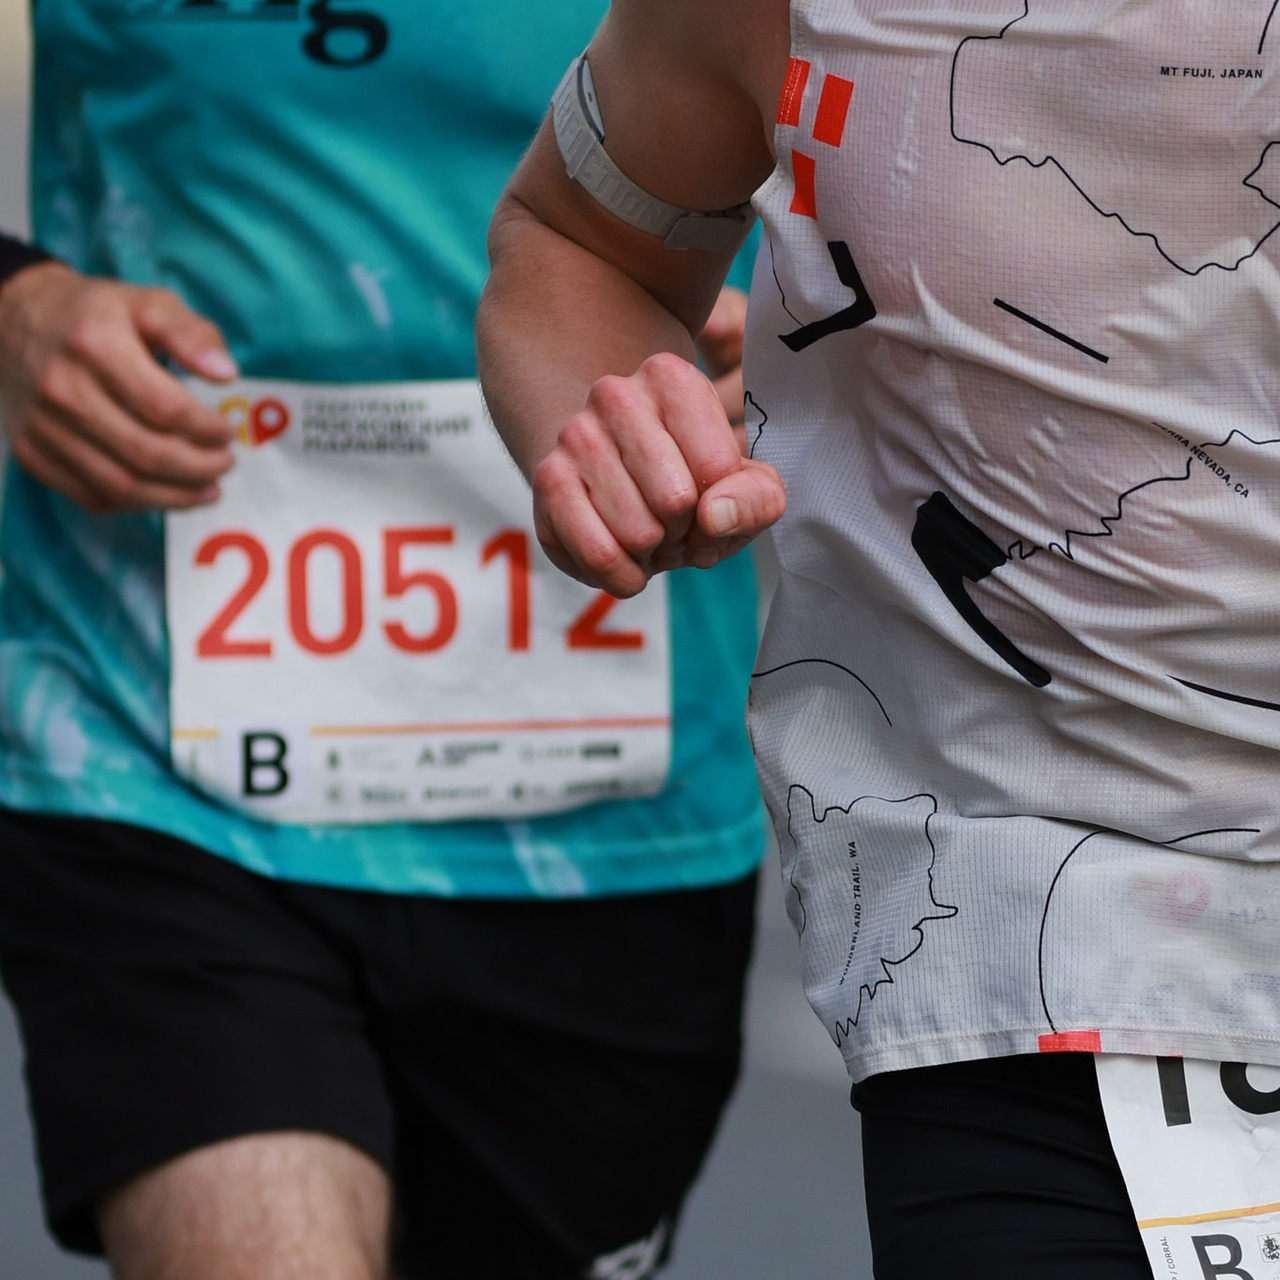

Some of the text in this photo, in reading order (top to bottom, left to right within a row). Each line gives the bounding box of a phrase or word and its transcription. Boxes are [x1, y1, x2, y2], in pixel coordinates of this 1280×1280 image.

[1160, 66, 1263, 79] MT FUJI, JAPAN
[1190, 445, 1231, 486] NEVADA,
[1234, 483, 1249, 498] CA
[243, 732, 289, 797] B
[848, 841, 857, 858] WA
[839, 902, 861, 986] WONDERLAND
[1160, 1236, 1176, 1269] CORRAL
